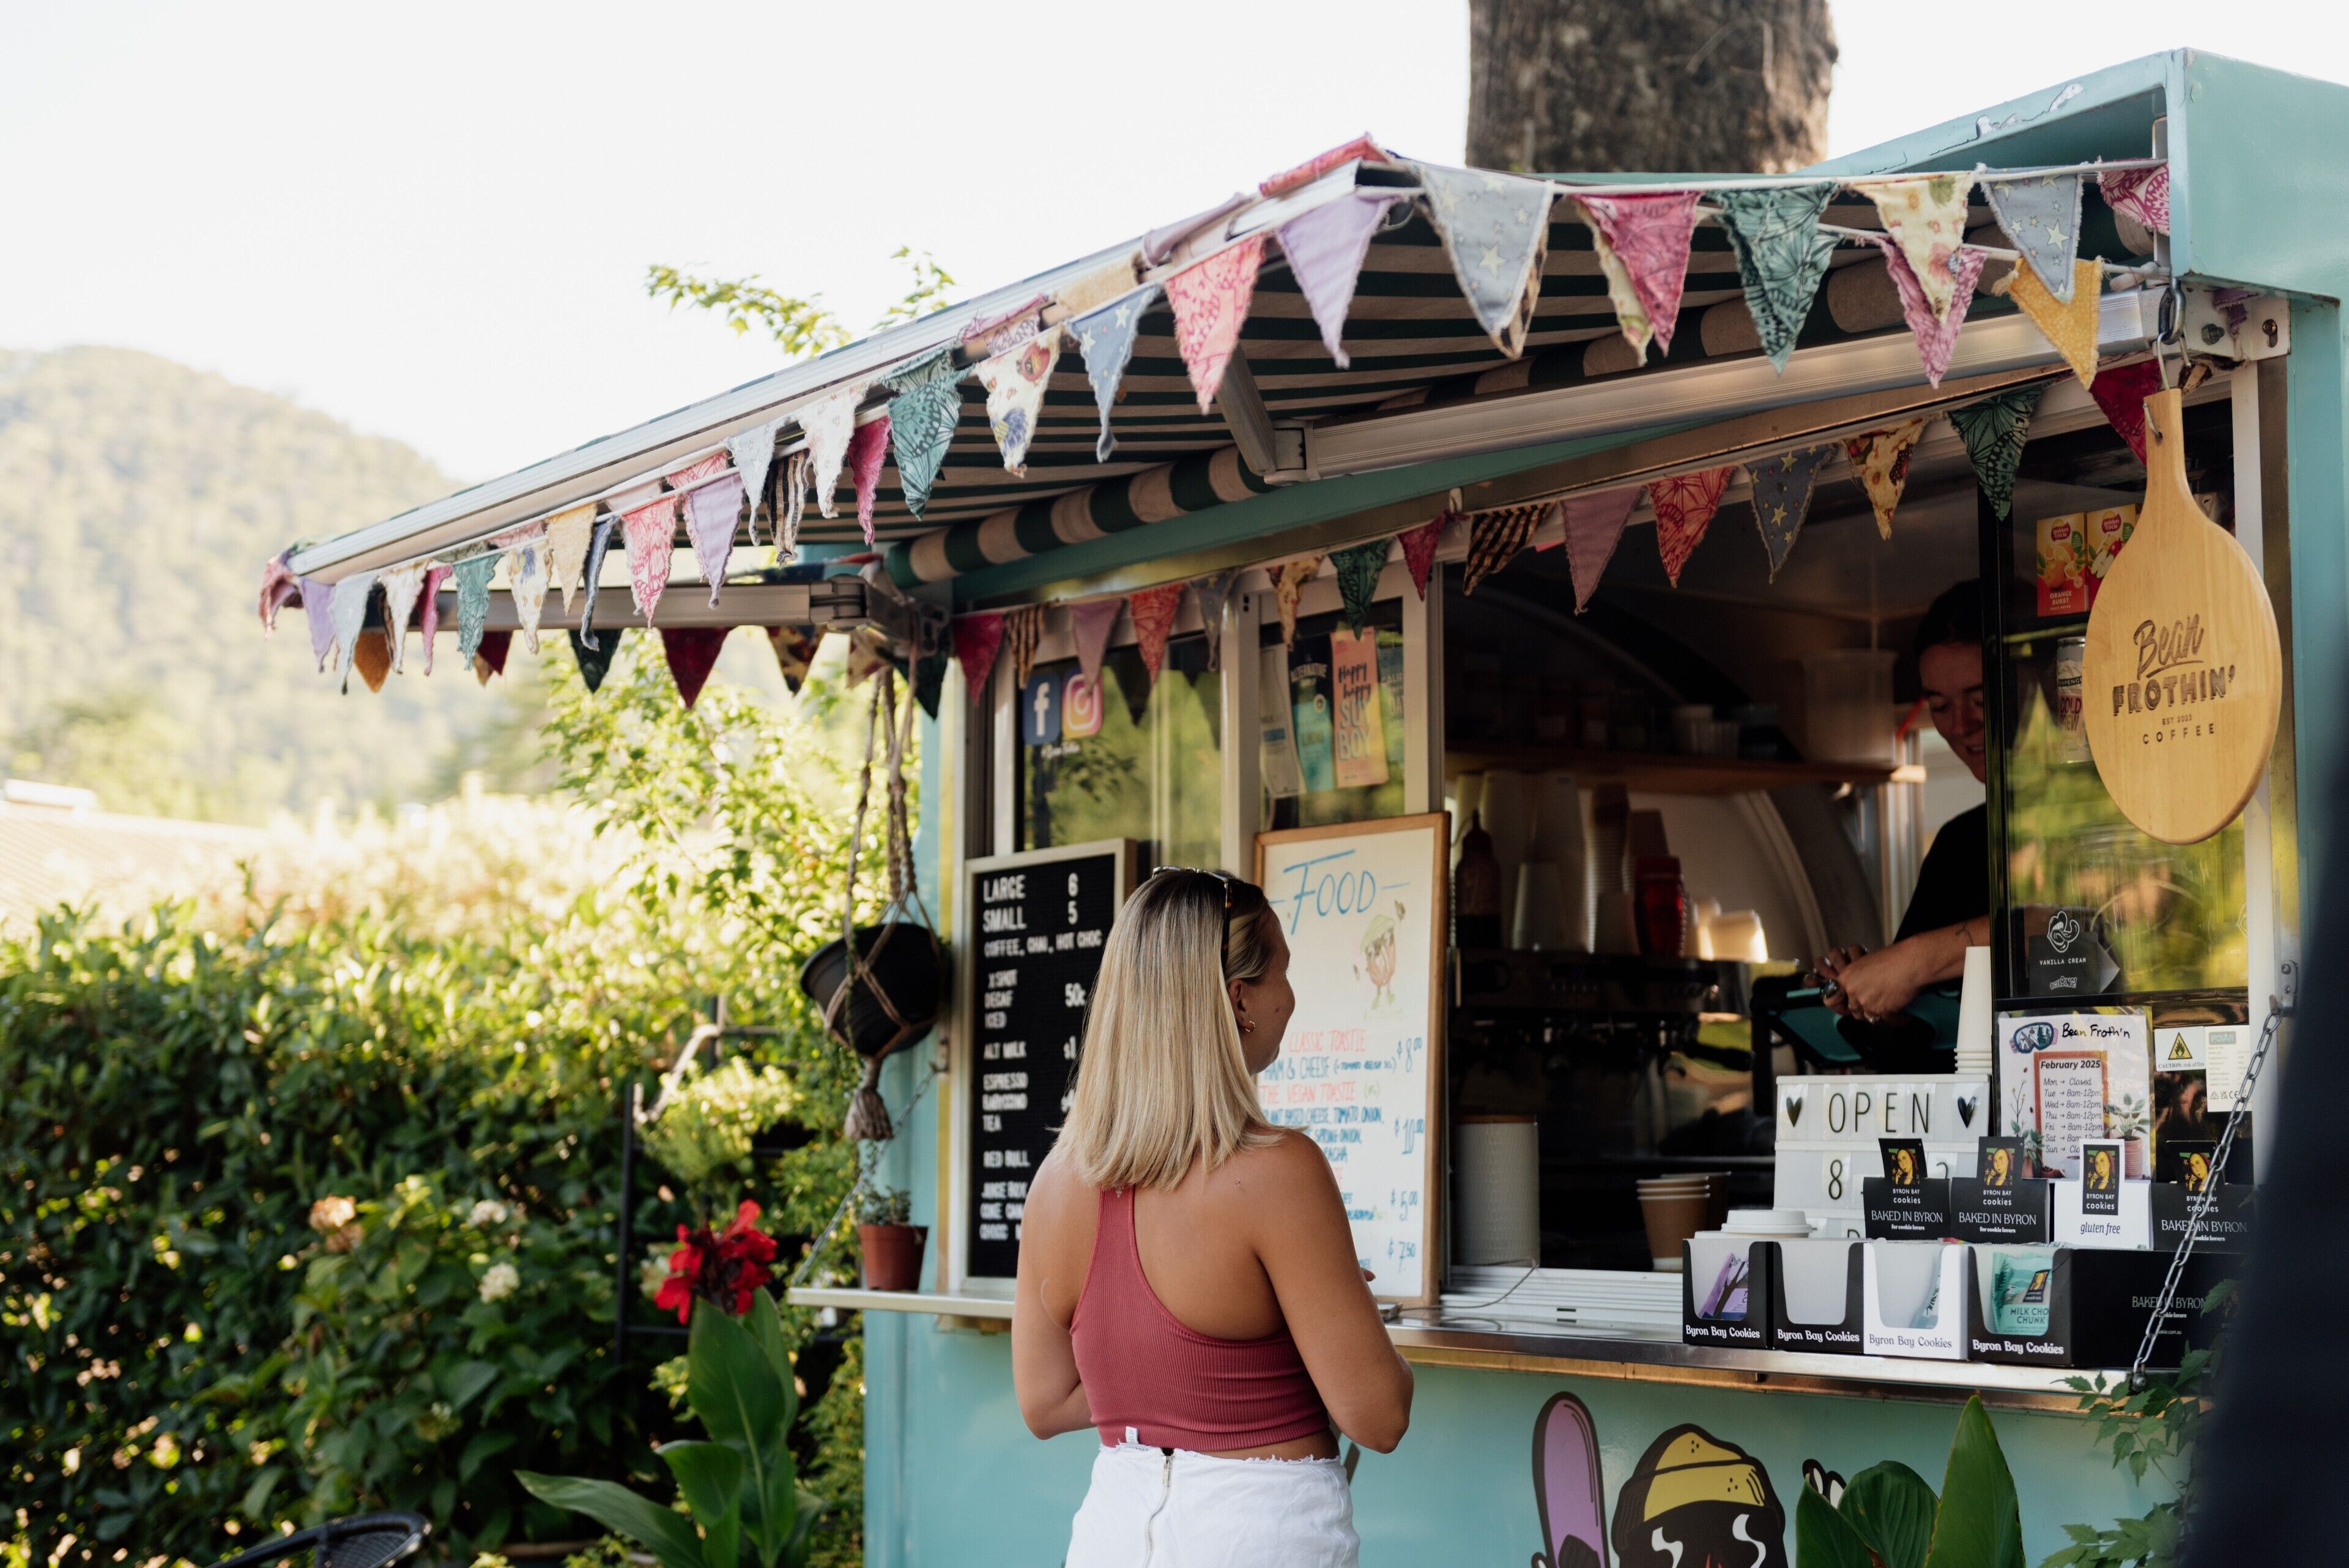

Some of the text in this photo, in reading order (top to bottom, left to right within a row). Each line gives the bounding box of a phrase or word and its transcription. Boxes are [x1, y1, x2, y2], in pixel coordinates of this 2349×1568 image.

[2134, 614, 2204, 680] Bean
[2058, 677, 2082, 686] SIXPENC
[2113, 664, 2235, 716] FROTHIN'
[1340, 699, 1370, 729] SOY
[2060, 697, 2081, 715] COLD
[2177, 715, 2192, 723] 2023
[2143, 723, 2214, 744] COFFEE
[1338, 730, 1371, 760] BOY
[983, 872, 1078, 903] LARGE 6
[1284, 849, 1376, 935] FOOD
[983, 901, 1078, 933] SMALL 5
[1056, 932, 1075, 950] HOT
[1077, 929, 1102, 948] CHOC
[984, 990, 1014, 1009] DECAF
[985, 1011, 1006, 1029] ICED
[2062, 1023, 2087, 1038] Bean
[1289, 1028, 1366, 1052] CLASSIC TOASTIE
[984, 1042, 1001, 1060] ALT
[1003, 1041, 1026, 1059] MILK
[1300, 1057, 1329, 1079] CHEESE
[2041, 1061, 2078, 1070] February
[983, 1072, 1028, 1091] ESPRESSO
[1259, 1085, 1280, 1104] THE
[1287, 1083, 1315, 1103] VEGAN
[1321, 1081, 1356, 1102] TOASTIE
[2066, 1090, 2102, 1098] 8am-12pm
[1828, 1092, 1929, 1134] OPEN
[2066, 1101, 2101, 1110] 8am-12pm
[982, 1115, 1002, 1132] TEA
[2066, 1112, 2102, 1121] 8am-12pm
[2067, 1123, 2104, 1132] 8am-12pm
[984, 1150, 1031, 1169] RED BULL
[1828, 1159, 1842, 1200] 8
[2086, 1202, 2115, 1210] cookies
[1871, 1210, 1943, 1223] BAKED IN BYRON
[1959, 1213, 2036, 1225] BAKED IN BYRON
[2080, 1222, 2120, 1235] gluten free
[2161, 1220, 2195, 1230] BAKED
[2211, 1222, 2247, 1232] BYRON
[2132, 1296, 2162, 1307] BAKED
[1686, 1325, 1761, 1339] Byron Bay Cookies
[1778, 1329, 1860, 1342] Byron Bay Cookies
[1869, 1334, 1952, 1348] Byron Bay Cookies
[1972, 1339, 2064, 1355] Byron Bay Cookies
